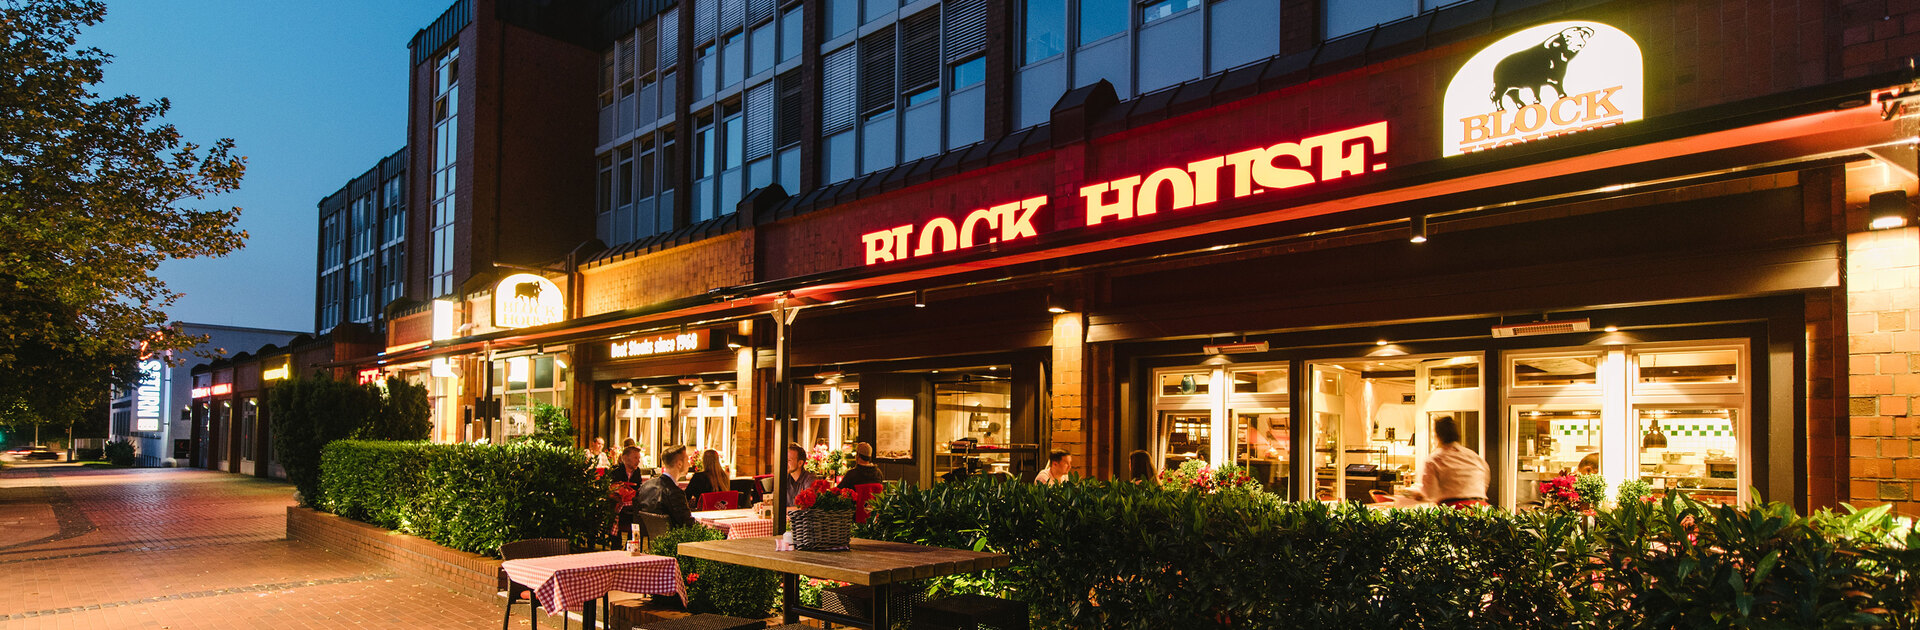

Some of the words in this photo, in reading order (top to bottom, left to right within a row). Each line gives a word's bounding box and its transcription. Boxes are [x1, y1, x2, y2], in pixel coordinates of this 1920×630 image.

[1459, 85, 1624, 146] BLOCK
[862, 195, 1047, 266] BLOCK
[1080, 121, 1388, 226] HOUSE
[654, 337, 676, 353] since
